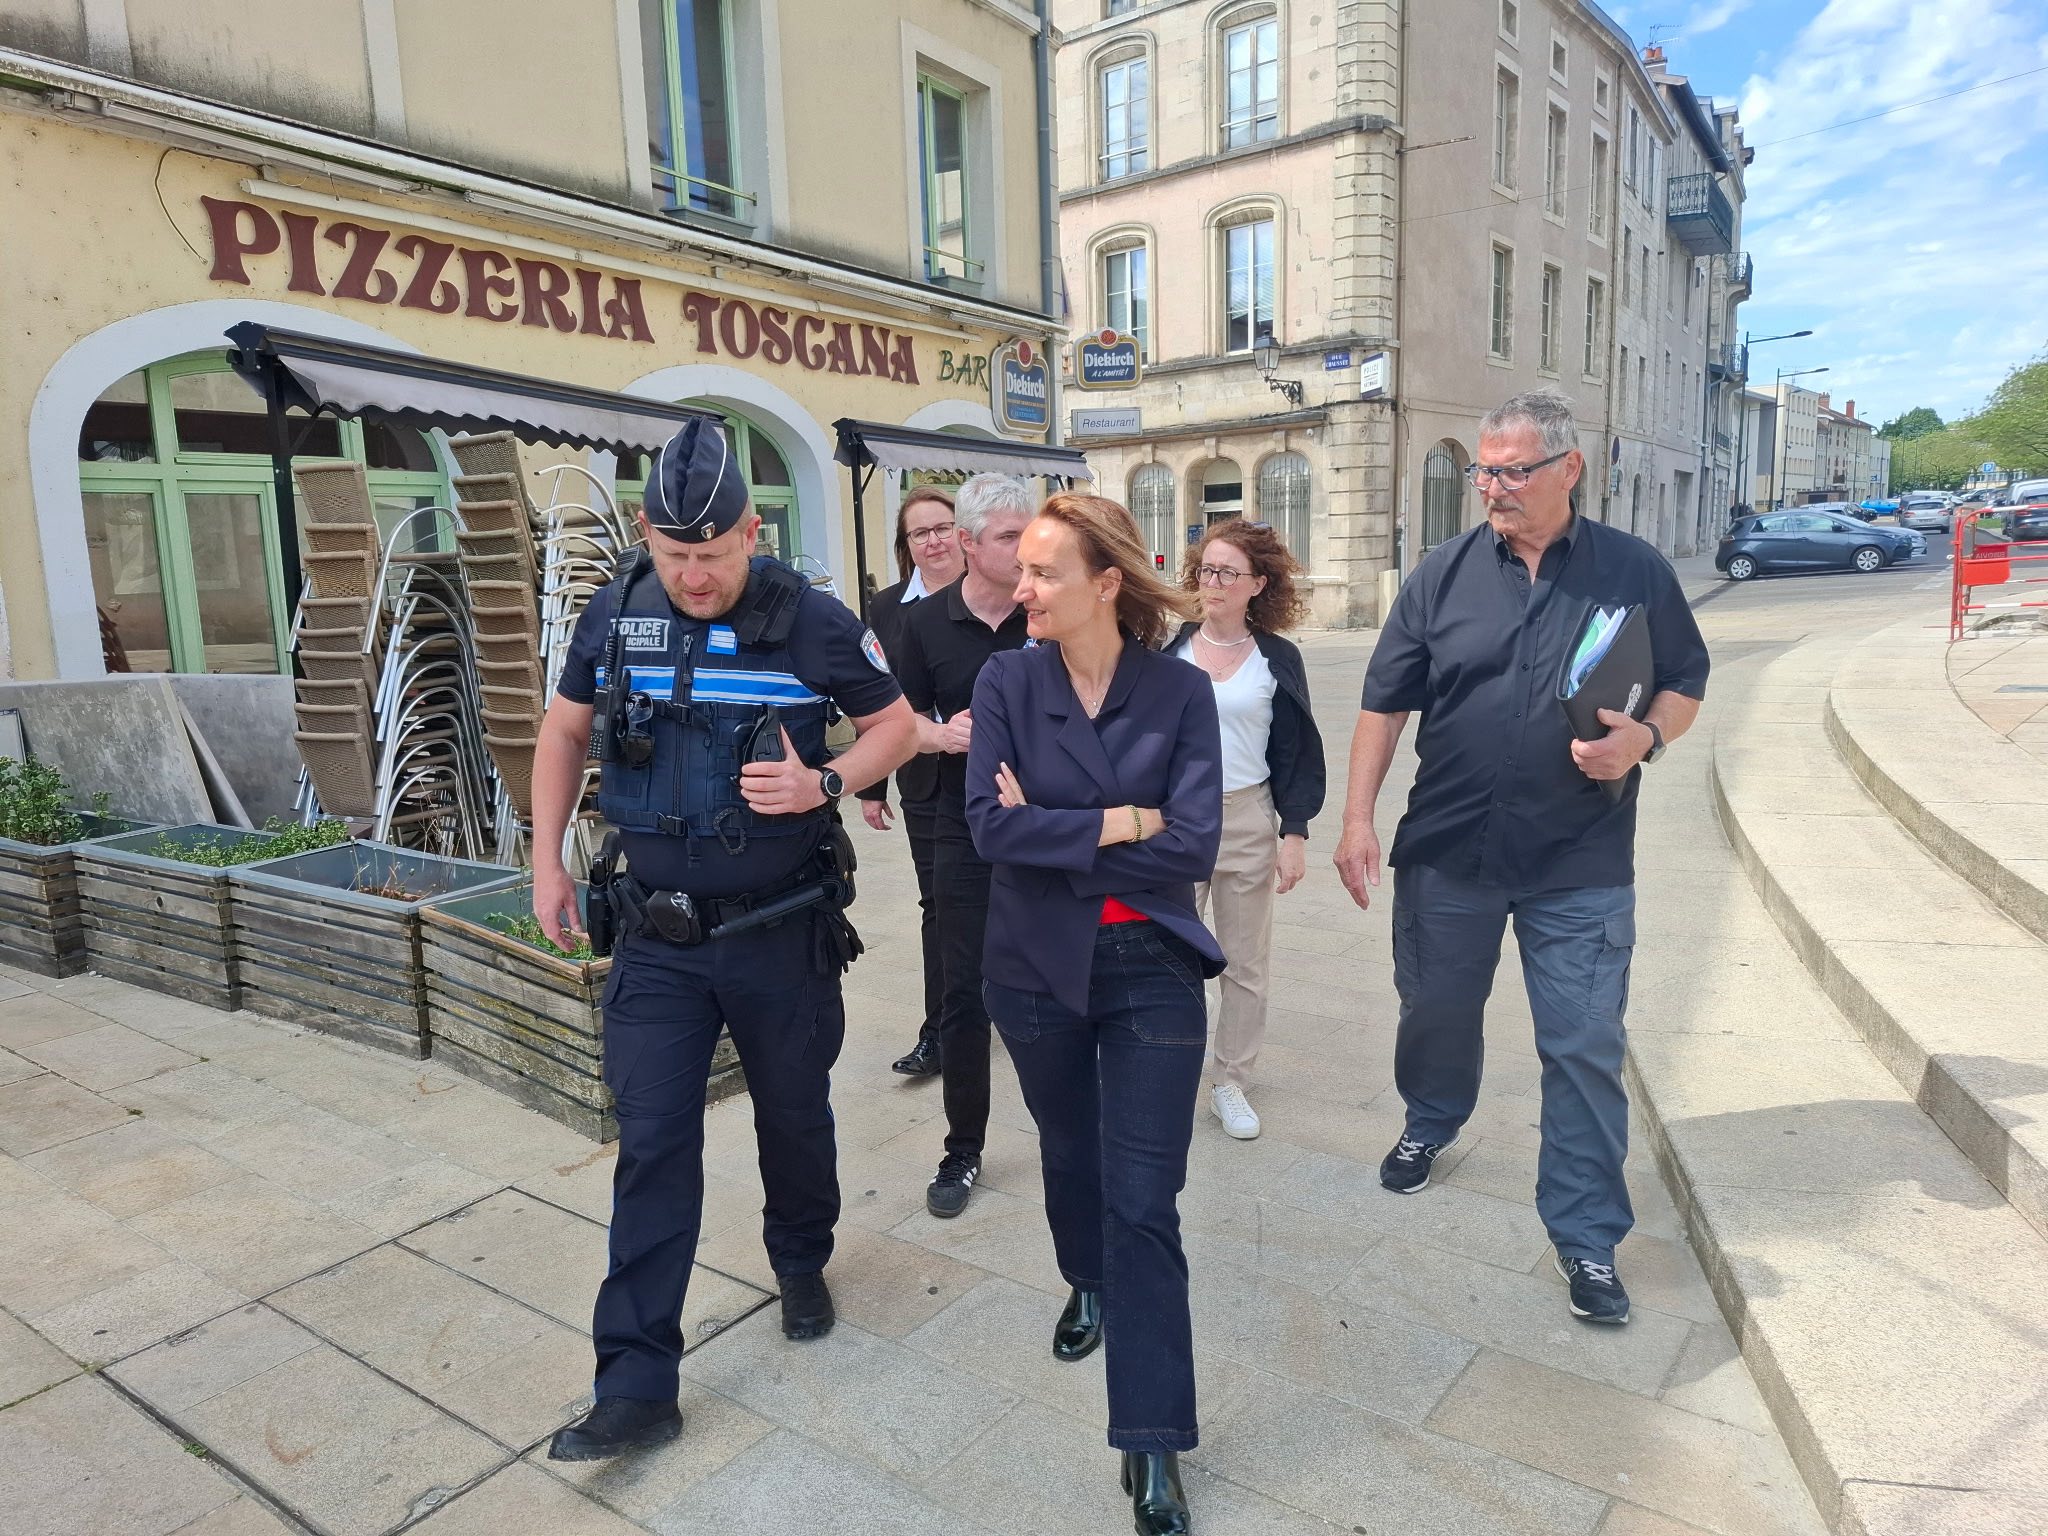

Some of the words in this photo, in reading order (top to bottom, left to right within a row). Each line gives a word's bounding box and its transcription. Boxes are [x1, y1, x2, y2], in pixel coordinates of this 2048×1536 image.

[200, 194, 656, 345] PIZZERIA
[682, 291, 920, 386] TOSCANA
[936, 350, 990, 392] BAR
[1084, 351, 1135, 367] Diekirch
[1006, 372, 1045, 398] Diekirch
[1082, 417, 1135, 429] Restaurant
